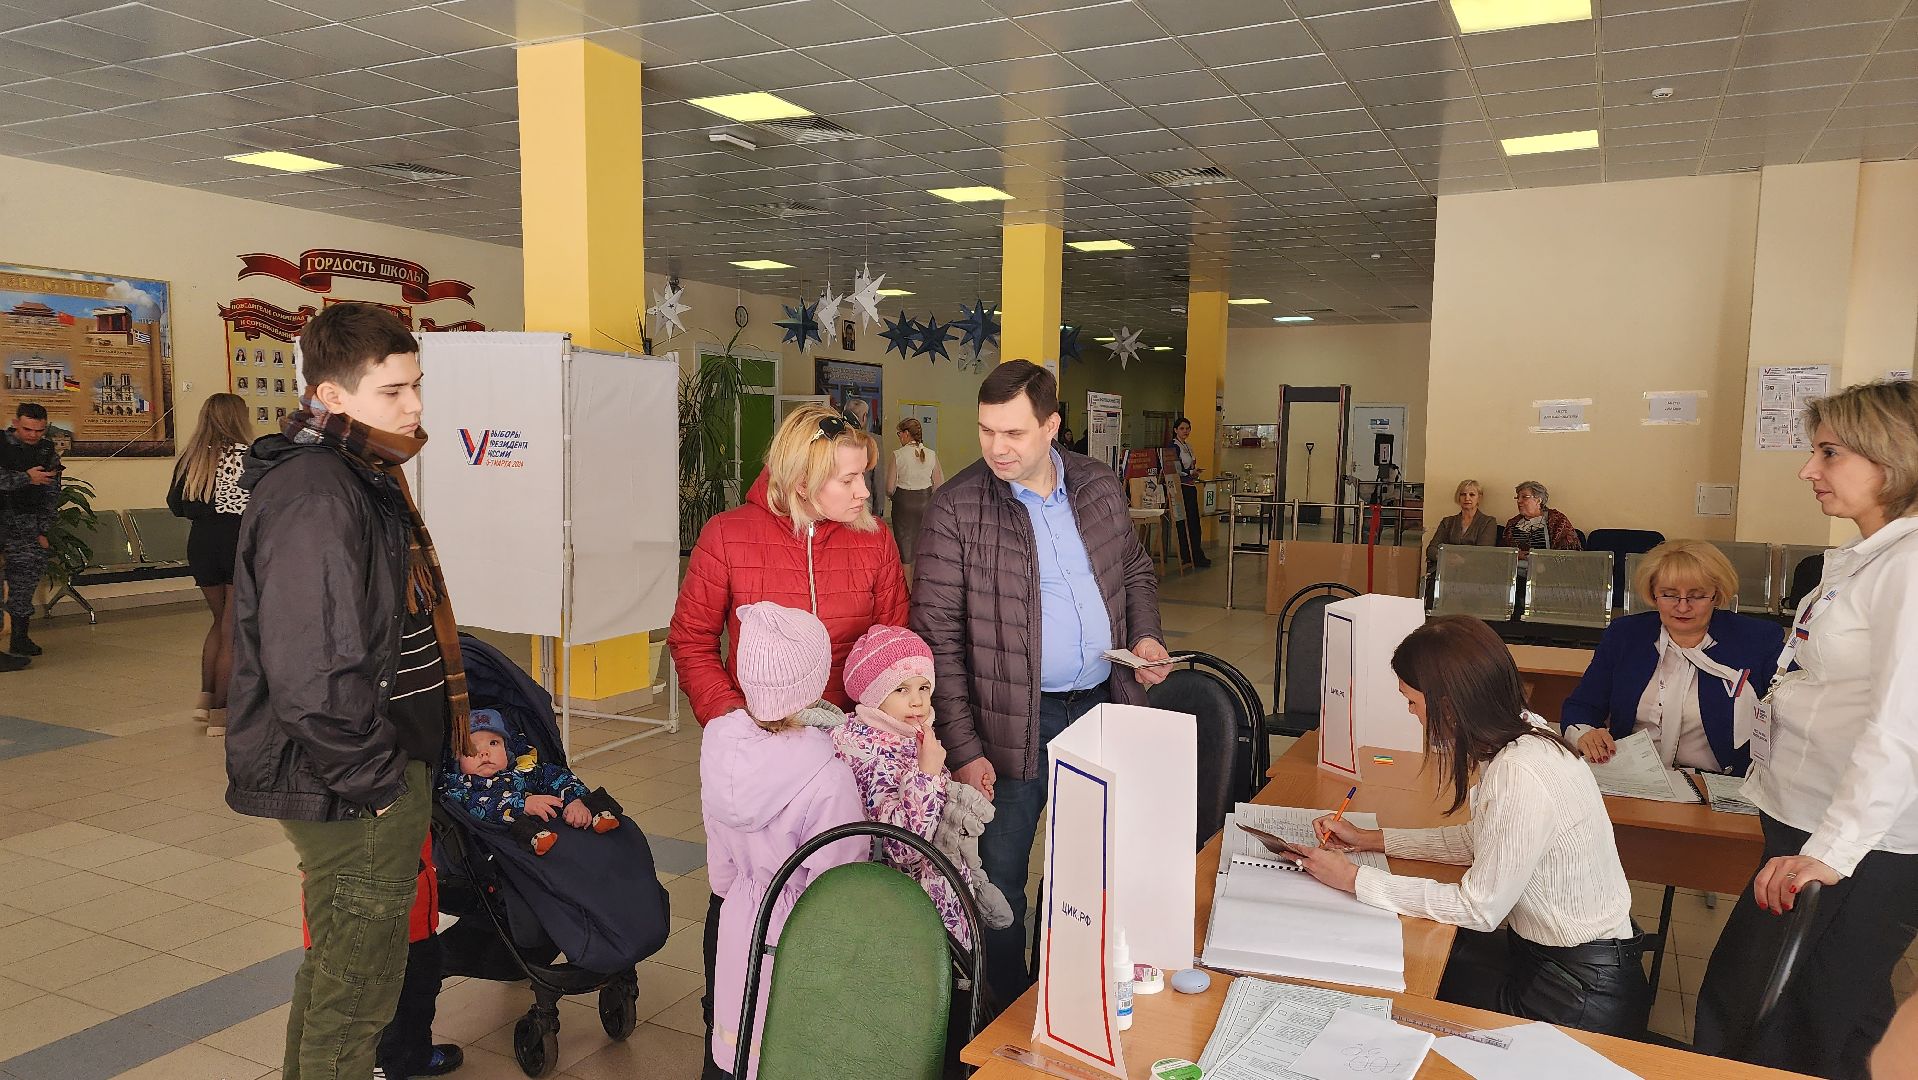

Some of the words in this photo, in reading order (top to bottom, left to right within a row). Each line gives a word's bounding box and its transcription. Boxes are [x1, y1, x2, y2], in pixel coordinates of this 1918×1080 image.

[307, 256, 376, 275] ГОРДОСТЬ
[380, 263, 424, 283] ШКОЛЫ
[490, 430, 521, 438] ВЫБОРЫ
[494, 459, 511, 468] МАРТА
[1061, 900, 1092, 927] ЦИК.РФ
